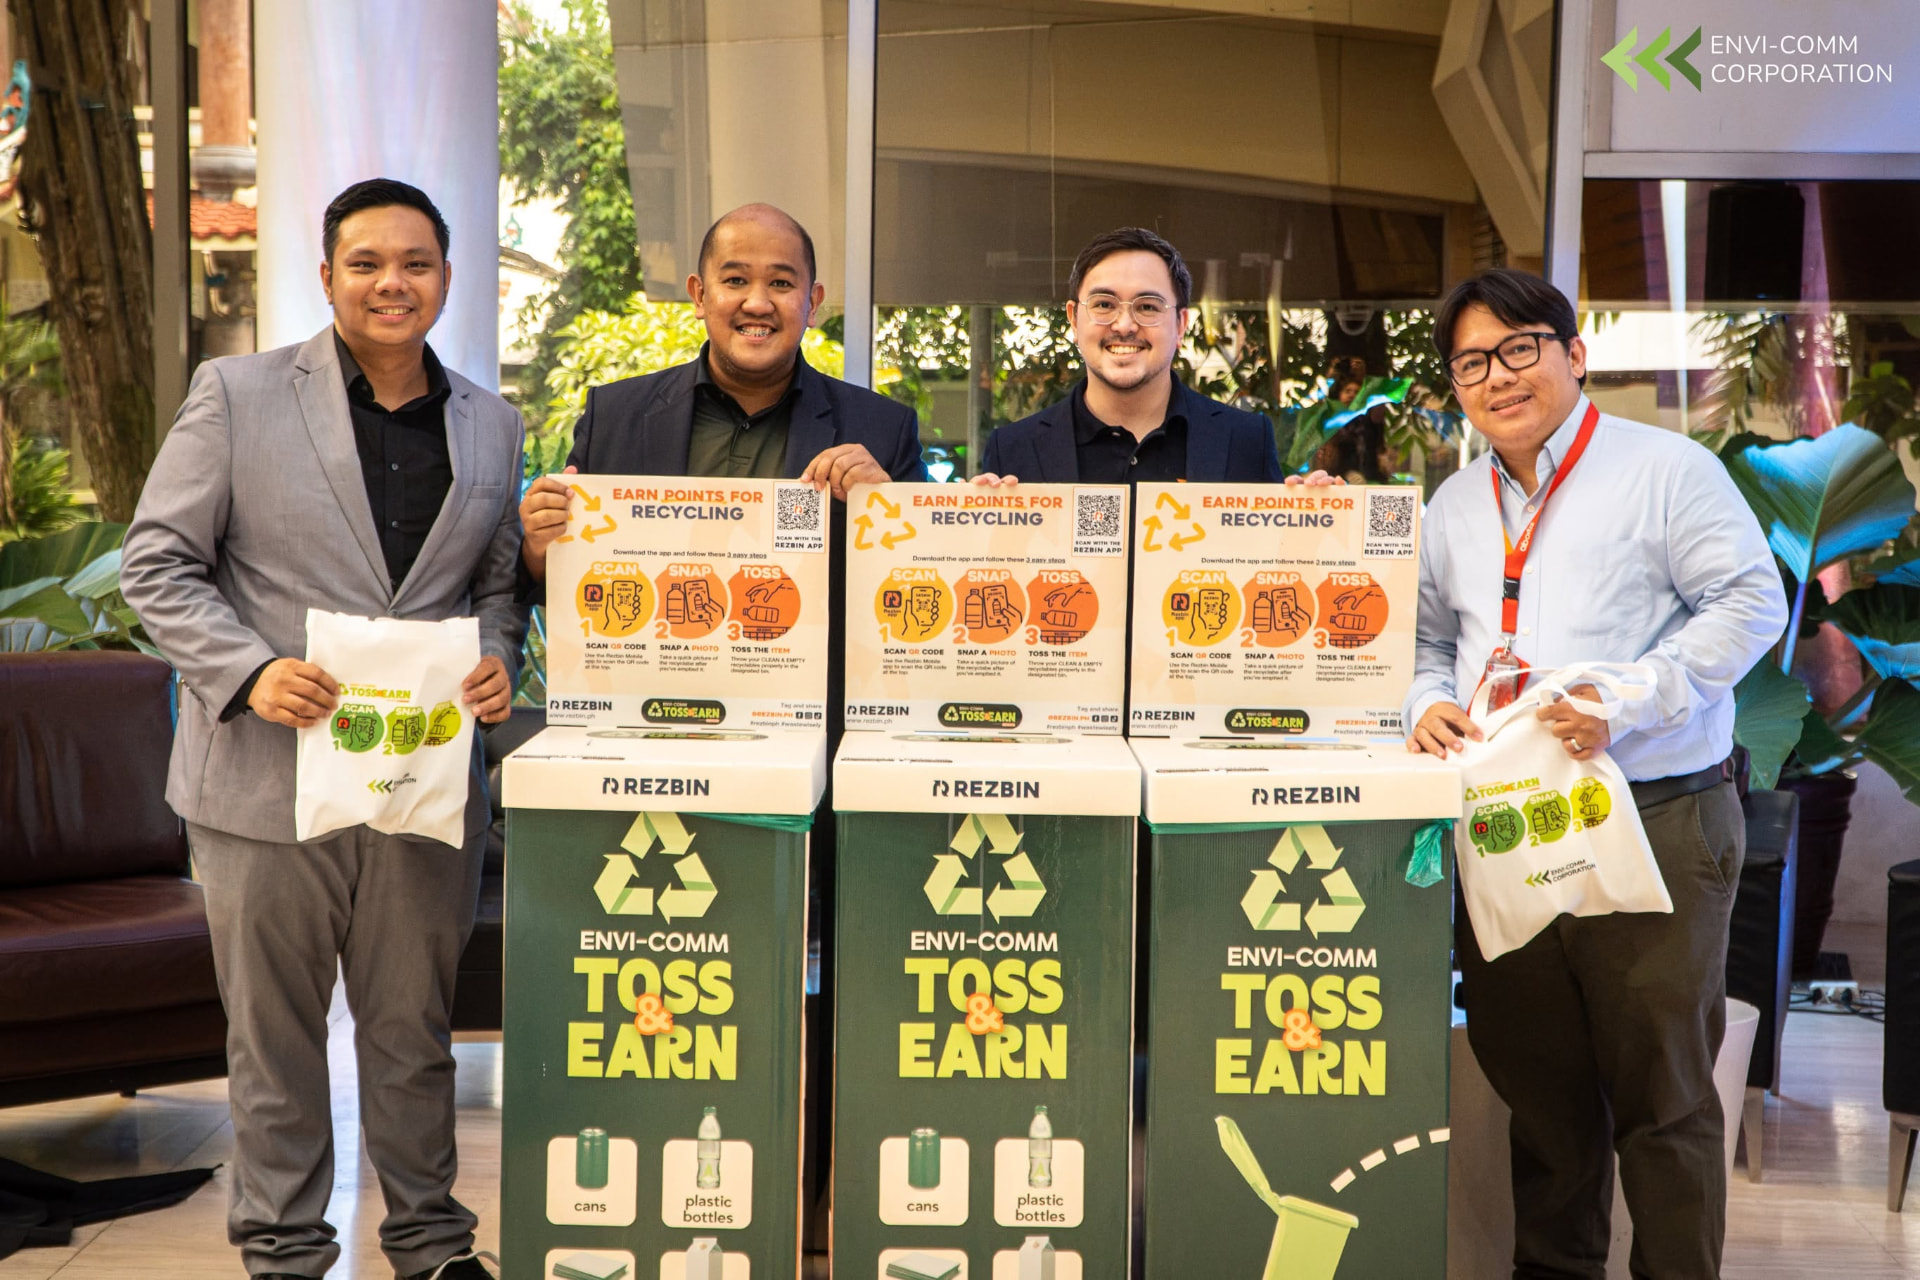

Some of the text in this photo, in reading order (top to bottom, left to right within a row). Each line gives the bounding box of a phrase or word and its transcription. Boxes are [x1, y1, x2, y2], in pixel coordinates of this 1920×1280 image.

[613, 488, 763, 503] EARN POINTS FOR
[913, 495, 1062, 508] EARN POINTS FOR
[1203, 497, 1353, 509] EARN POINTS FOR
[632, 506, 744, 520] RECYCLING
[932, 512, 1043, 526] RECYCLING
[1221, 513, 1334, 528] RECYCLING
[593, 564, 637, 576] SCAN
[669, 565, 712, 577] SNAP
[742, 567, 781, 578] TOSS
[892, 569, 935, 582] SCAN
[967, 570, 1010, 582] SNAP
[1040, 571, 1079, 582] TOSS
[1180, 572, 1225, 584] SCAN
[1256, 573, 1300, 585] SNAP
[1330, 574, 1369, 585] TOSS
[581, 620, 590, 637] 1
[655, 622, 668, 638] 2
[728, 623, 740, 640] 3
[880, 626, 888, 643] 1
[953, 627, 966, 643] 2
[1025, 627, 1037, 645] 3
[1167, 629, 1175, 646] 1
[1241, 631, 1254, 647] 2
[1314, 632, 1326, 649] 3
[350, 687, 411, 698] TOSS EARN
[343, 705, 374, 713] SCAN
[562, 701, 612, 711] REZBIN
[662, 708, 720, 718] TOSS EARN
[860, 706, 909, 716] REZBIN
[959, 711, 1016, 722] TOSS EARN
[1145, 711, 1195, 721] REZBIN
[1247, 717, 1303, 728] TOSS EARN
[333, 741, 339, 750] 1
[383, 745, 393, 755] 2
[624, 778, 709, 795] REZBIN
[955, 781, 1039, 797] REZBIN
[1478, 785, 1506, 798] TOSS
[1510, 777, 1540, 791] EARN
[1274, 787, 1360, 804] REZBIN
[1529, 792, 1557, 804] SNAP
[1477, 803, 1508, 816] SCAN
[1573, 821, 1583, 832] 3
[1529, 836, 1539, 847] 2
[1477, 847, 1485, 857] 1
[580, 931, 728, 953] ENVI-COMM
[911, 932, 1057, 952] ENVI-COMM
[1227, 947, 1376, 967] ENVI-COMM
[574, 958, 734, 1015] TOSS
[905, 958, 1064, 1014] TOSS
[1221, 974, 1383, 1031] TOSS
[635, 993, 674, 1035] &
[965, 992, 1004, 1035] &
[1283, 1009, 1322, 1051] &
[567, 1022, 737, 1080] EARN
[899, 1023, 1067, 1079] EARN
[1216, 1038, 1386, 1095] EARN
[574, 1201, 606, 1212] cans
[685, 1195, 732, 1209] plastic
[907, 1201, 939, 1213] cans
[1017, 1194, 1064, 1208] plastic
[683, 1211, 733, 1224] bottles
[1016, 1210, 1065, 1222] bottles
